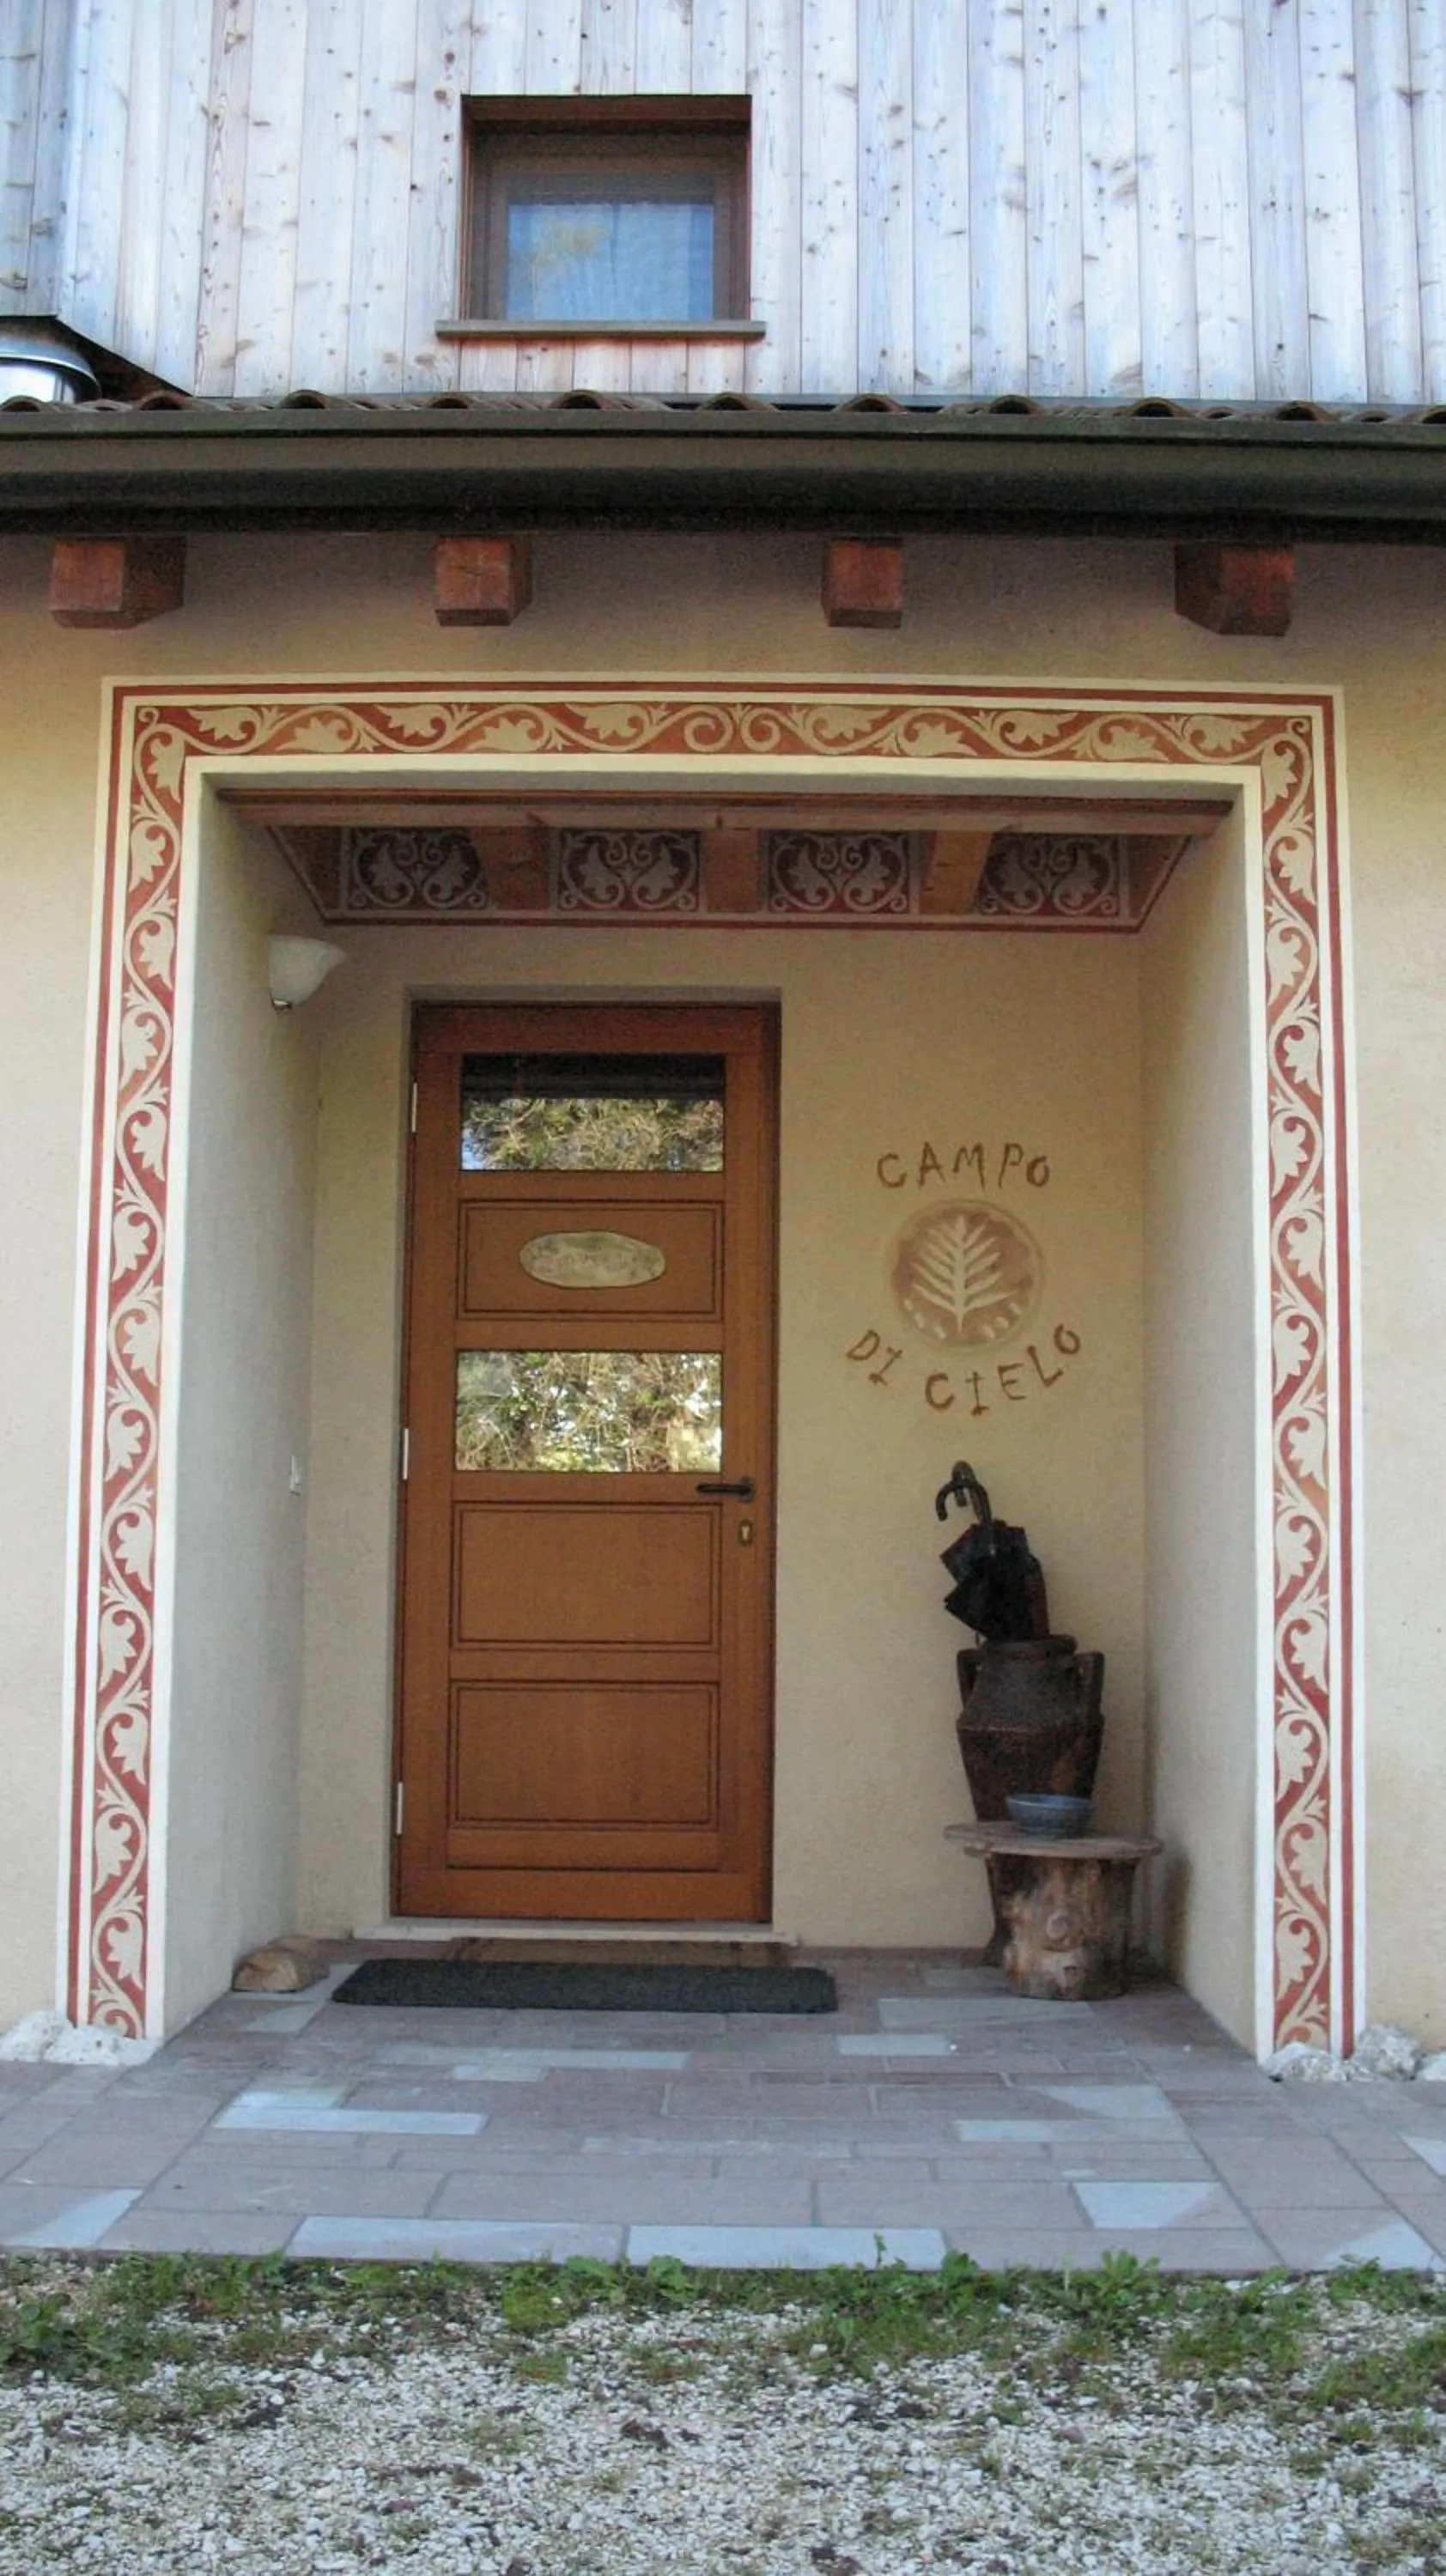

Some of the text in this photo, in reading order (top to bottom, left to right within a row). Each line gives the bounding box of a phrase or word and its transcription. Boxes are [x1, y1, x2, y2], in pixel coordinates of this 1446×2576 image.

[876, 1141, 1050, 1192] CAMPO
[846, 1323, 1082, 1417] DI CIELO
